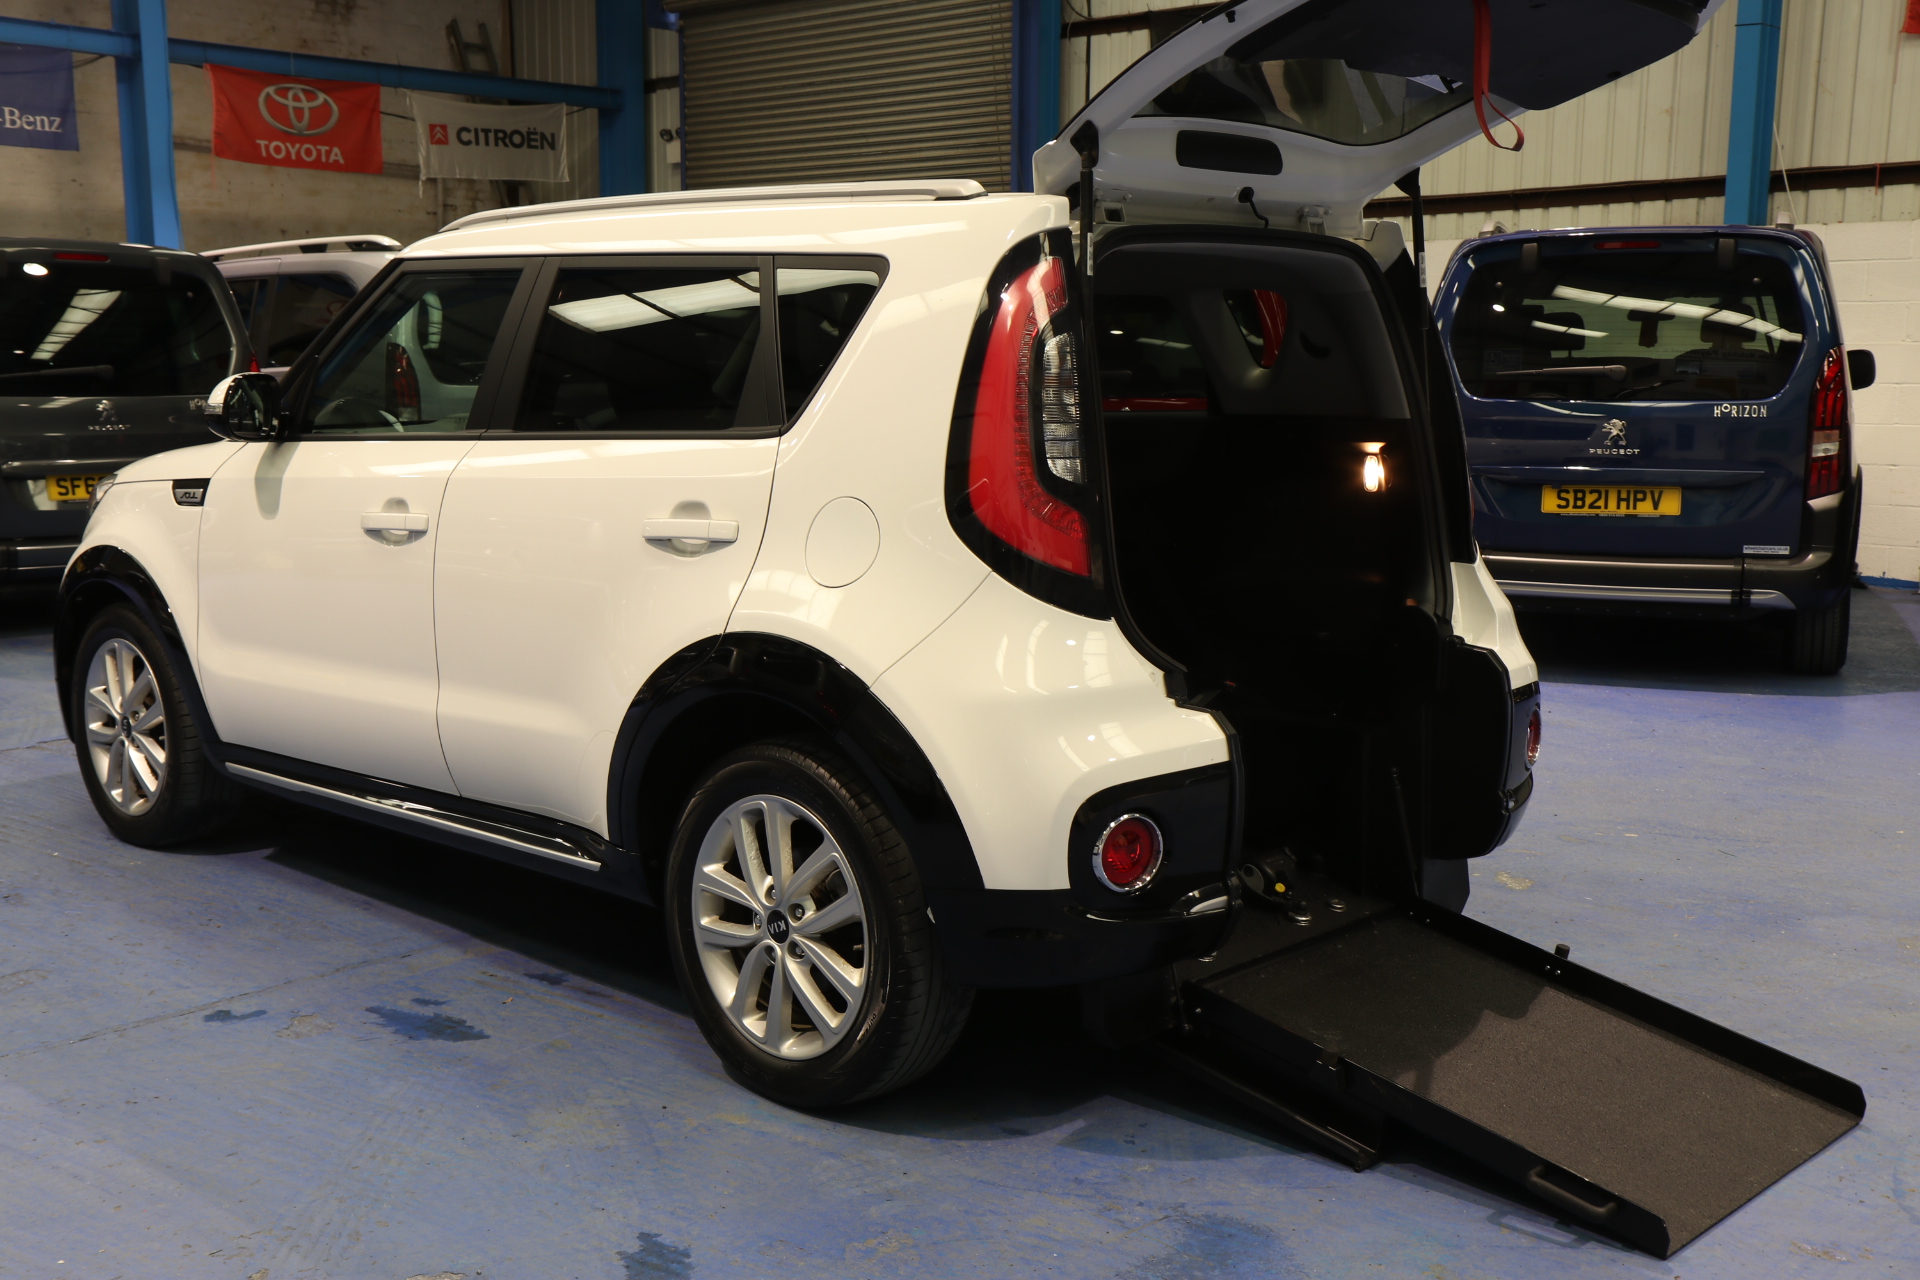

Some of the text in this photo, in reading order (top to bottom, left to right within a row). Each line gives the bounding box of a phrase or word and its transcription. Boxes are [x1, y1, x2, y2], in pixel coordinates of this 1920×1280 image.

[456, 126, 556, 150] CITROËN
[255, 139, 345, 164] TOYOTA
[1713, 403, 1767, 418] HORIZON
[56, 476, 103, 497] SF6
[1556, 488, 1664, 511] SB21 HPV
[768, 920, 787, 934] KIA
